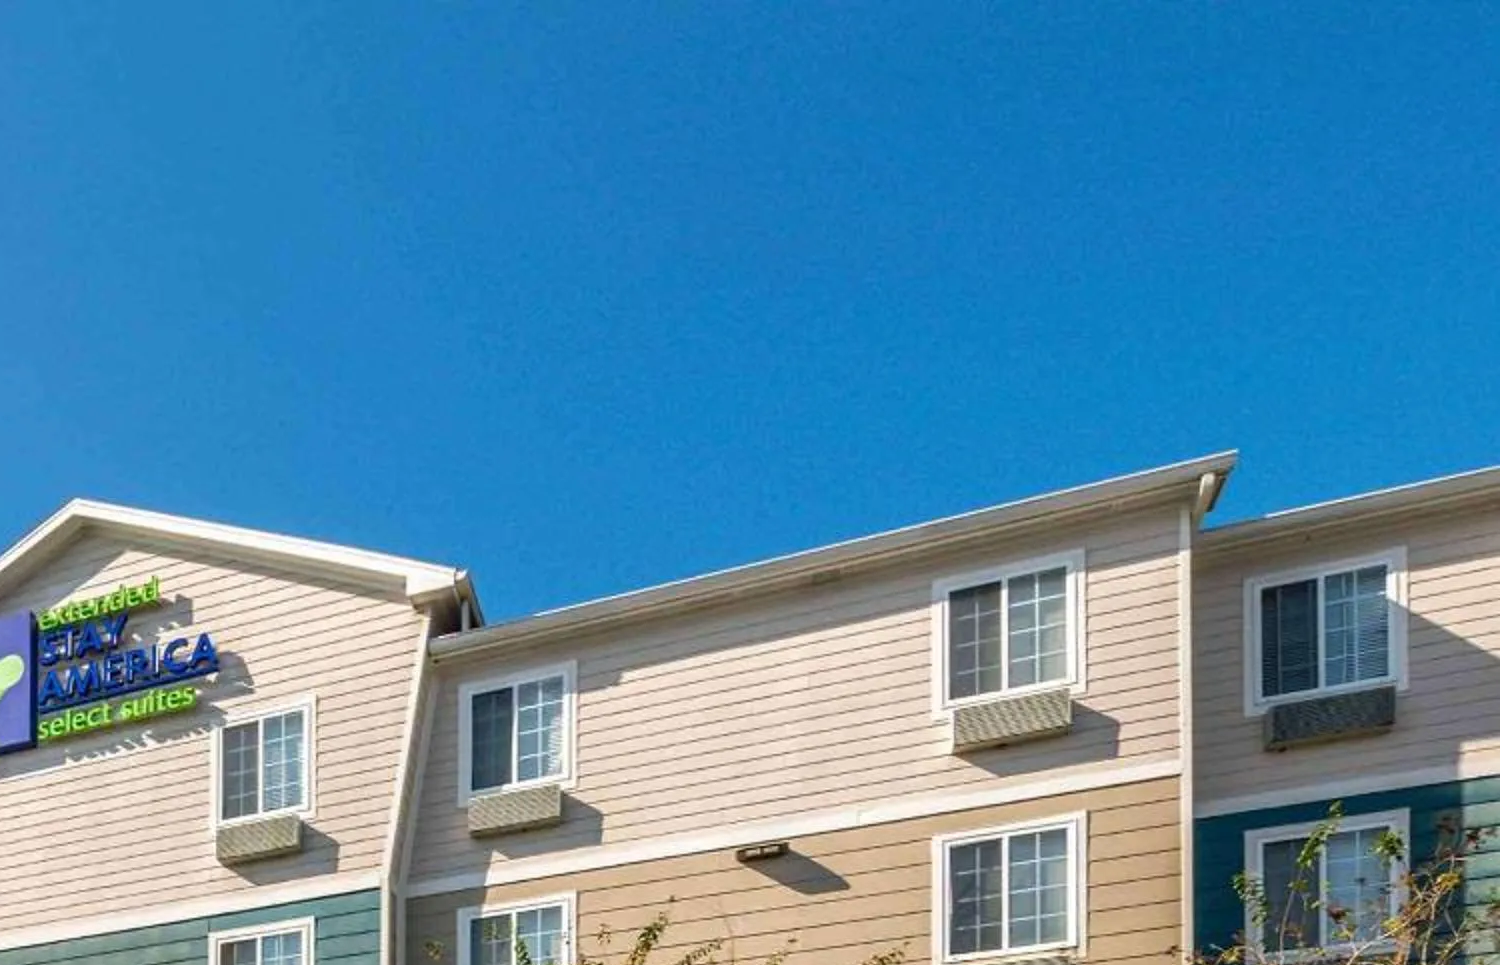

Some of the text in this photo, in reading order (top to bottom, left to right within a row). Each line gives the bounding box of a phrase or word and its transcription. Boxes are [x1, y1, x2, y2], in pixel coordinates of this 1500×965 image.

[39, 576, 160, 630] extended
[39, 612, 128, 666] STAY
[39, 632, 219, 706] AMERICA
[37, 686, 197, 741] select suites
